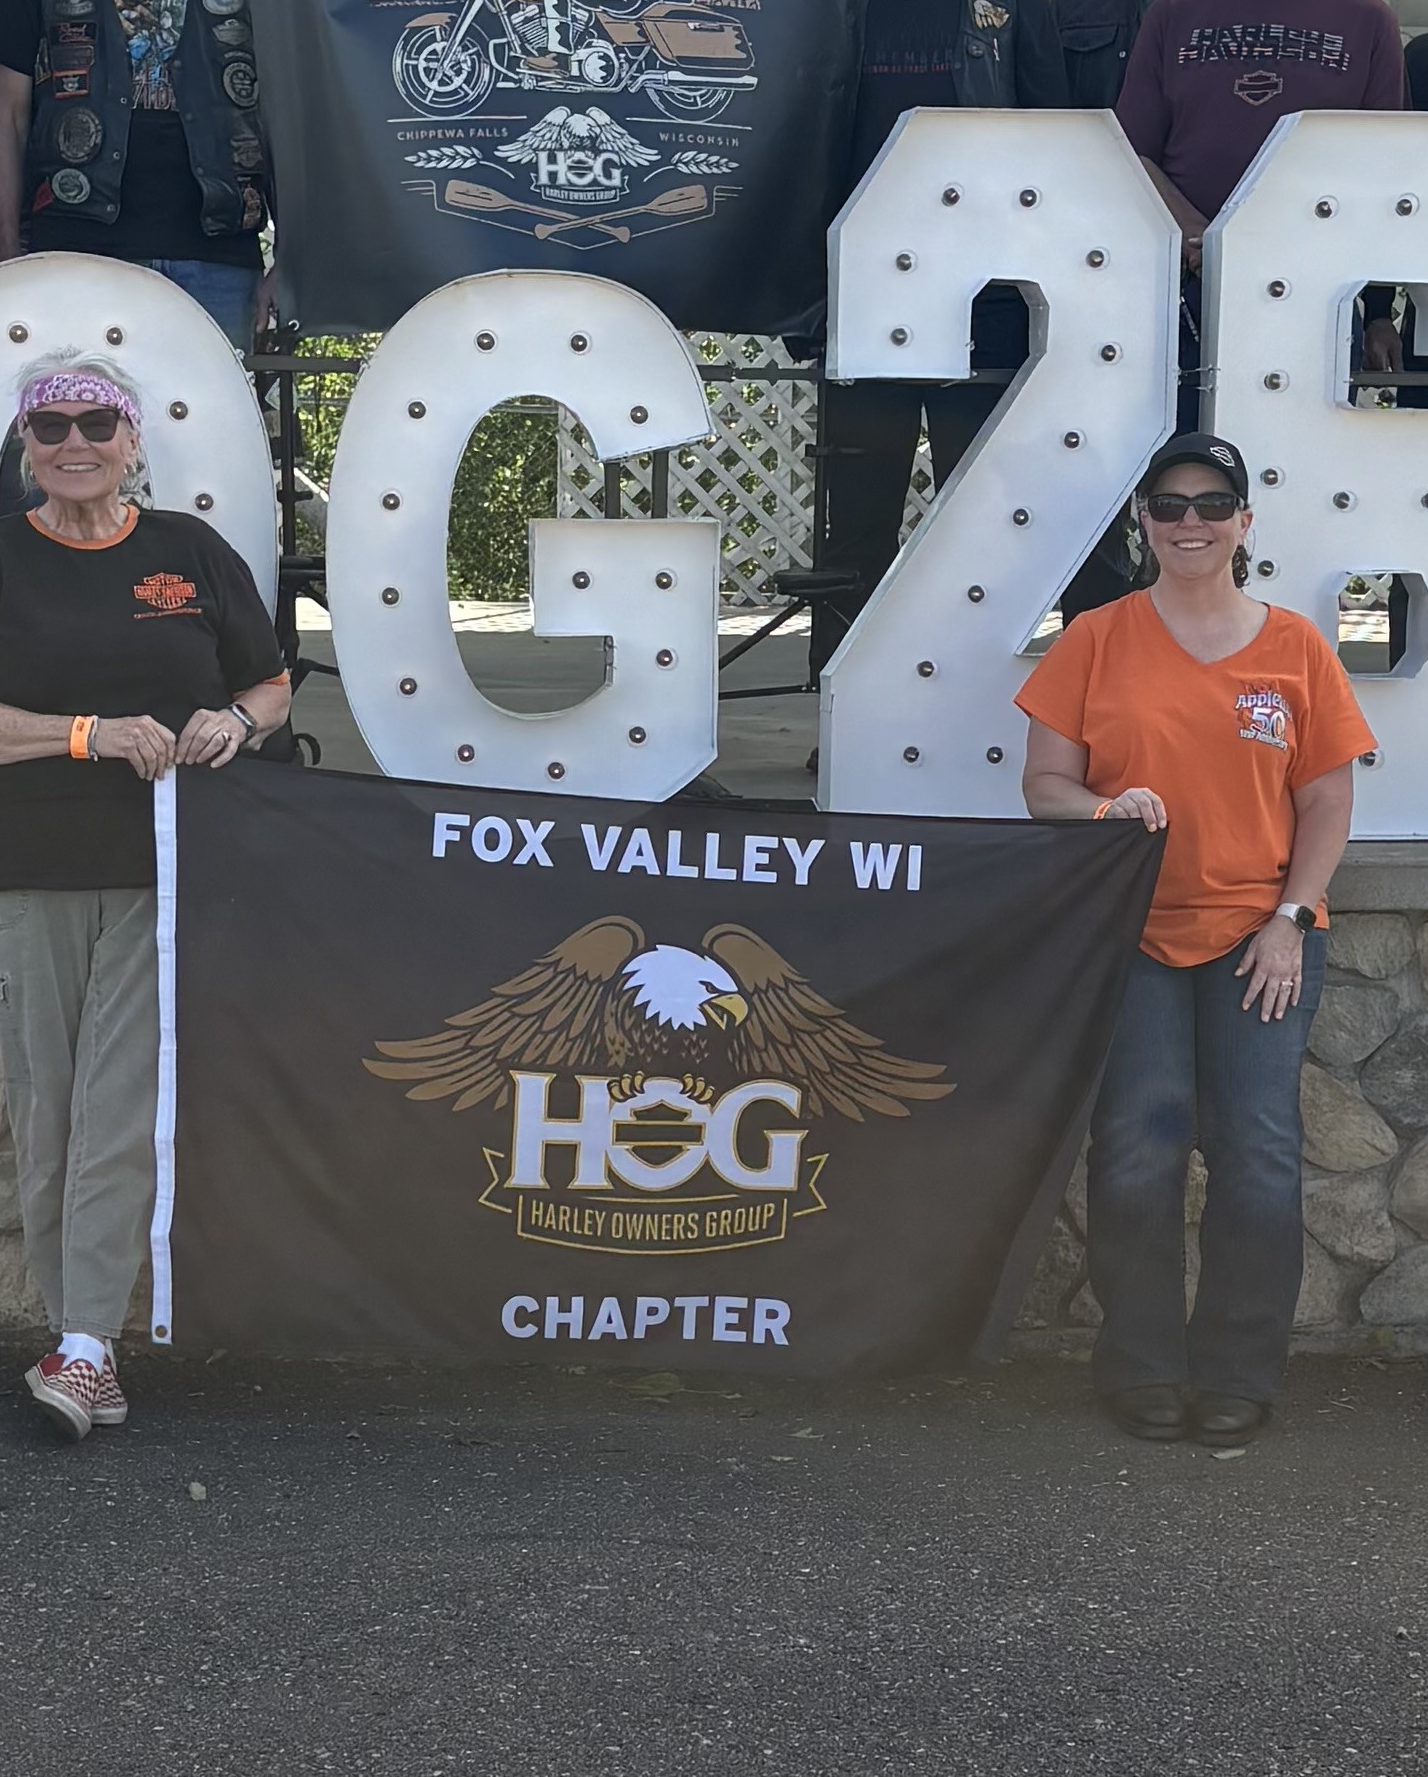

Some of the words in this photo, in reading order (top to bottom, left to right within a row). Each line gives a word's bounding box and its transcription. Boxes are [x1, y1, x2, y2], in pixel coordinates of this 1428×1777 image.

[397, 128, 465, 141] CHIPPEWA
[469, 127, 508, 140] FALLS
[659, 131, 740, 147] WISCONSIN
[536, 151, 622, 187] HOG
[1250, 706, 1286, 740] 50
[432, 812, 556, 868] FOX
[580, 822, 826, 887] VALLEY
[849, 841, 924, 892] WI
[504, 1069, 810, 1192] HOG
[530, 1198, 606, 1237] HARLEY
[611, 1212, 700, 1242] OWNERS
[704, 1202, 776, 1237] GROUP
[501, 1294, 792, 1346] CHAPTER
